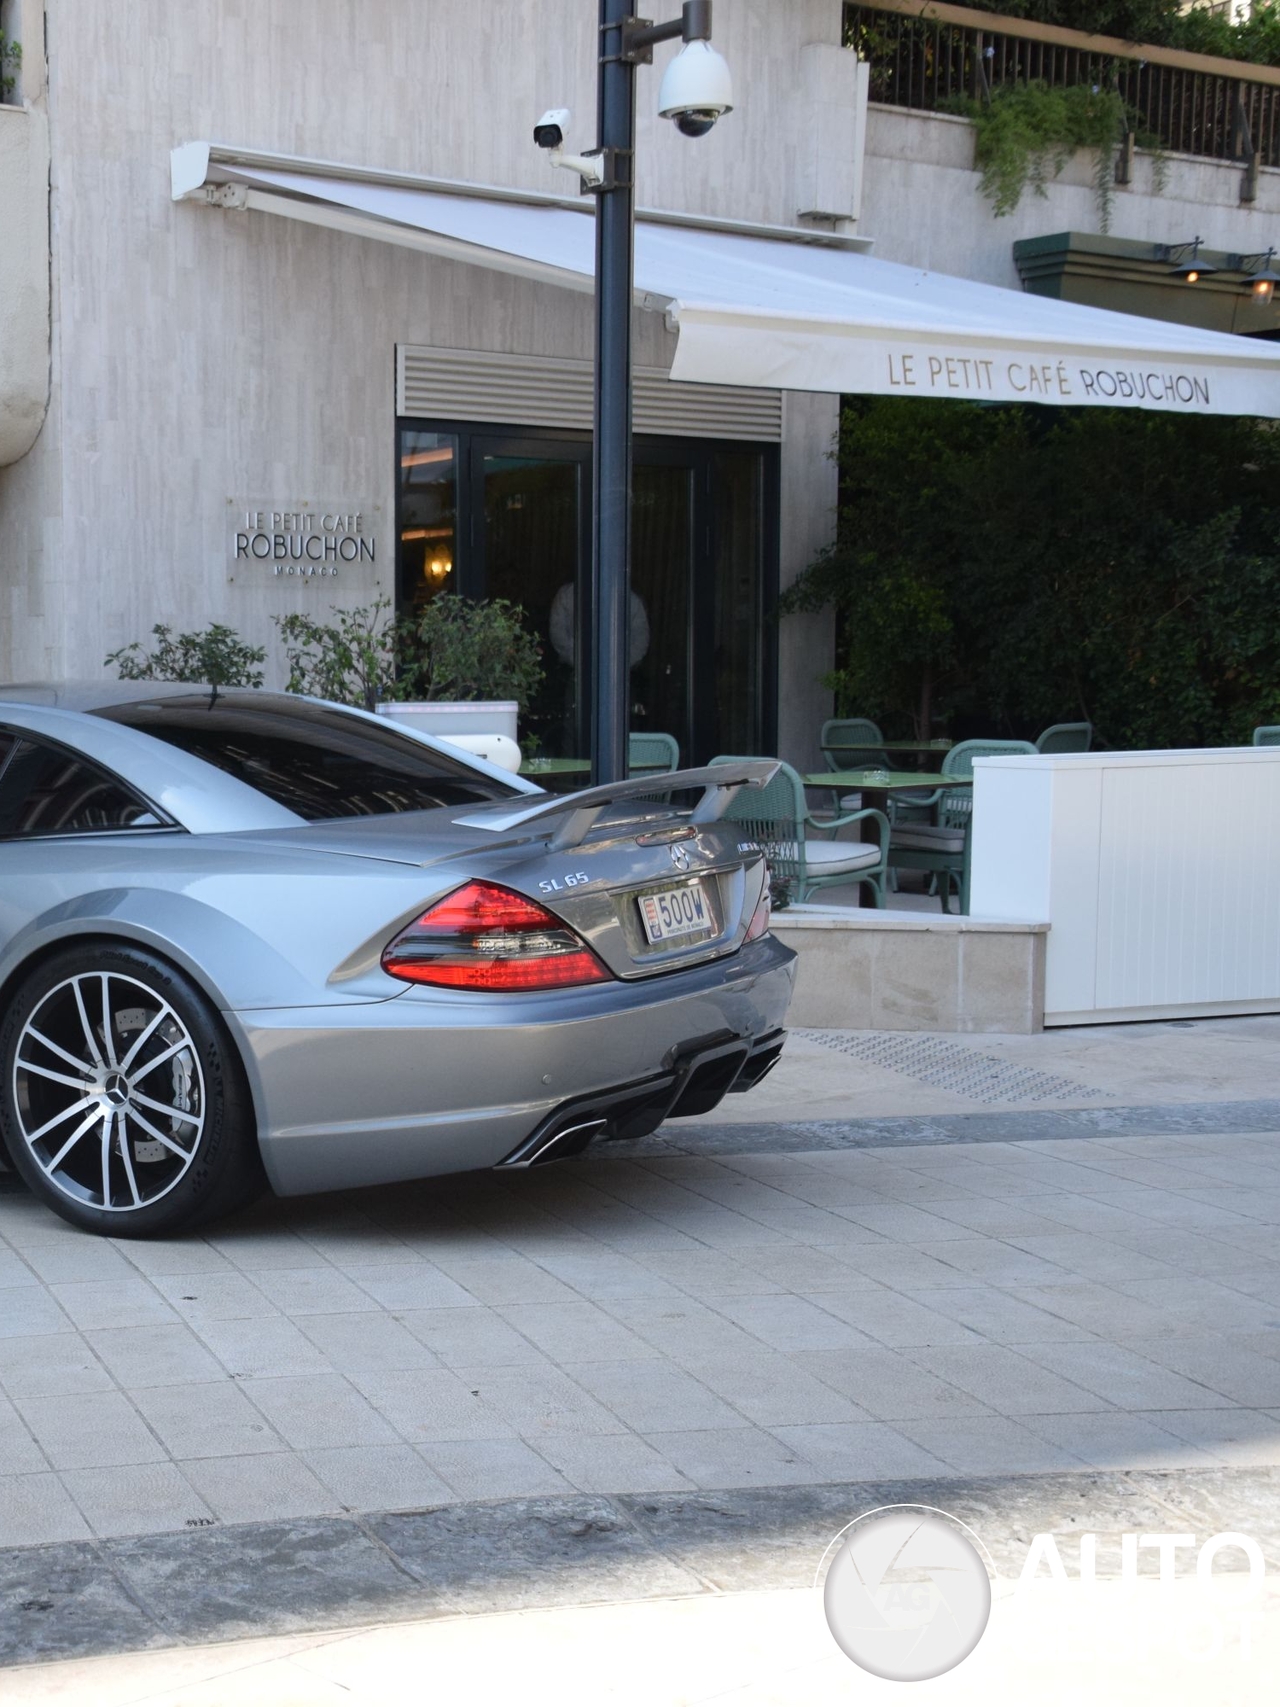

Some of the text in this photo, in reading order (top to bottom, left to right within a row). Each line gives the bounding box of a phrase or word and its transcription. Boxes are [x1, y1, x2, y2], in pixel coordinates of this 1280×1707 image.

[887, 353, 1210, 405] LE PETIT CAFÉ ROBUCHON
[246, 512, 363, 533] LE PETIT CAFÉ
[234, 533, 376, 562] ROBUCHON
[274, 566, 339, 577] MONACO
[538, 871, 589, 893] SL 65
[658, 888, 705, 928] 500W
